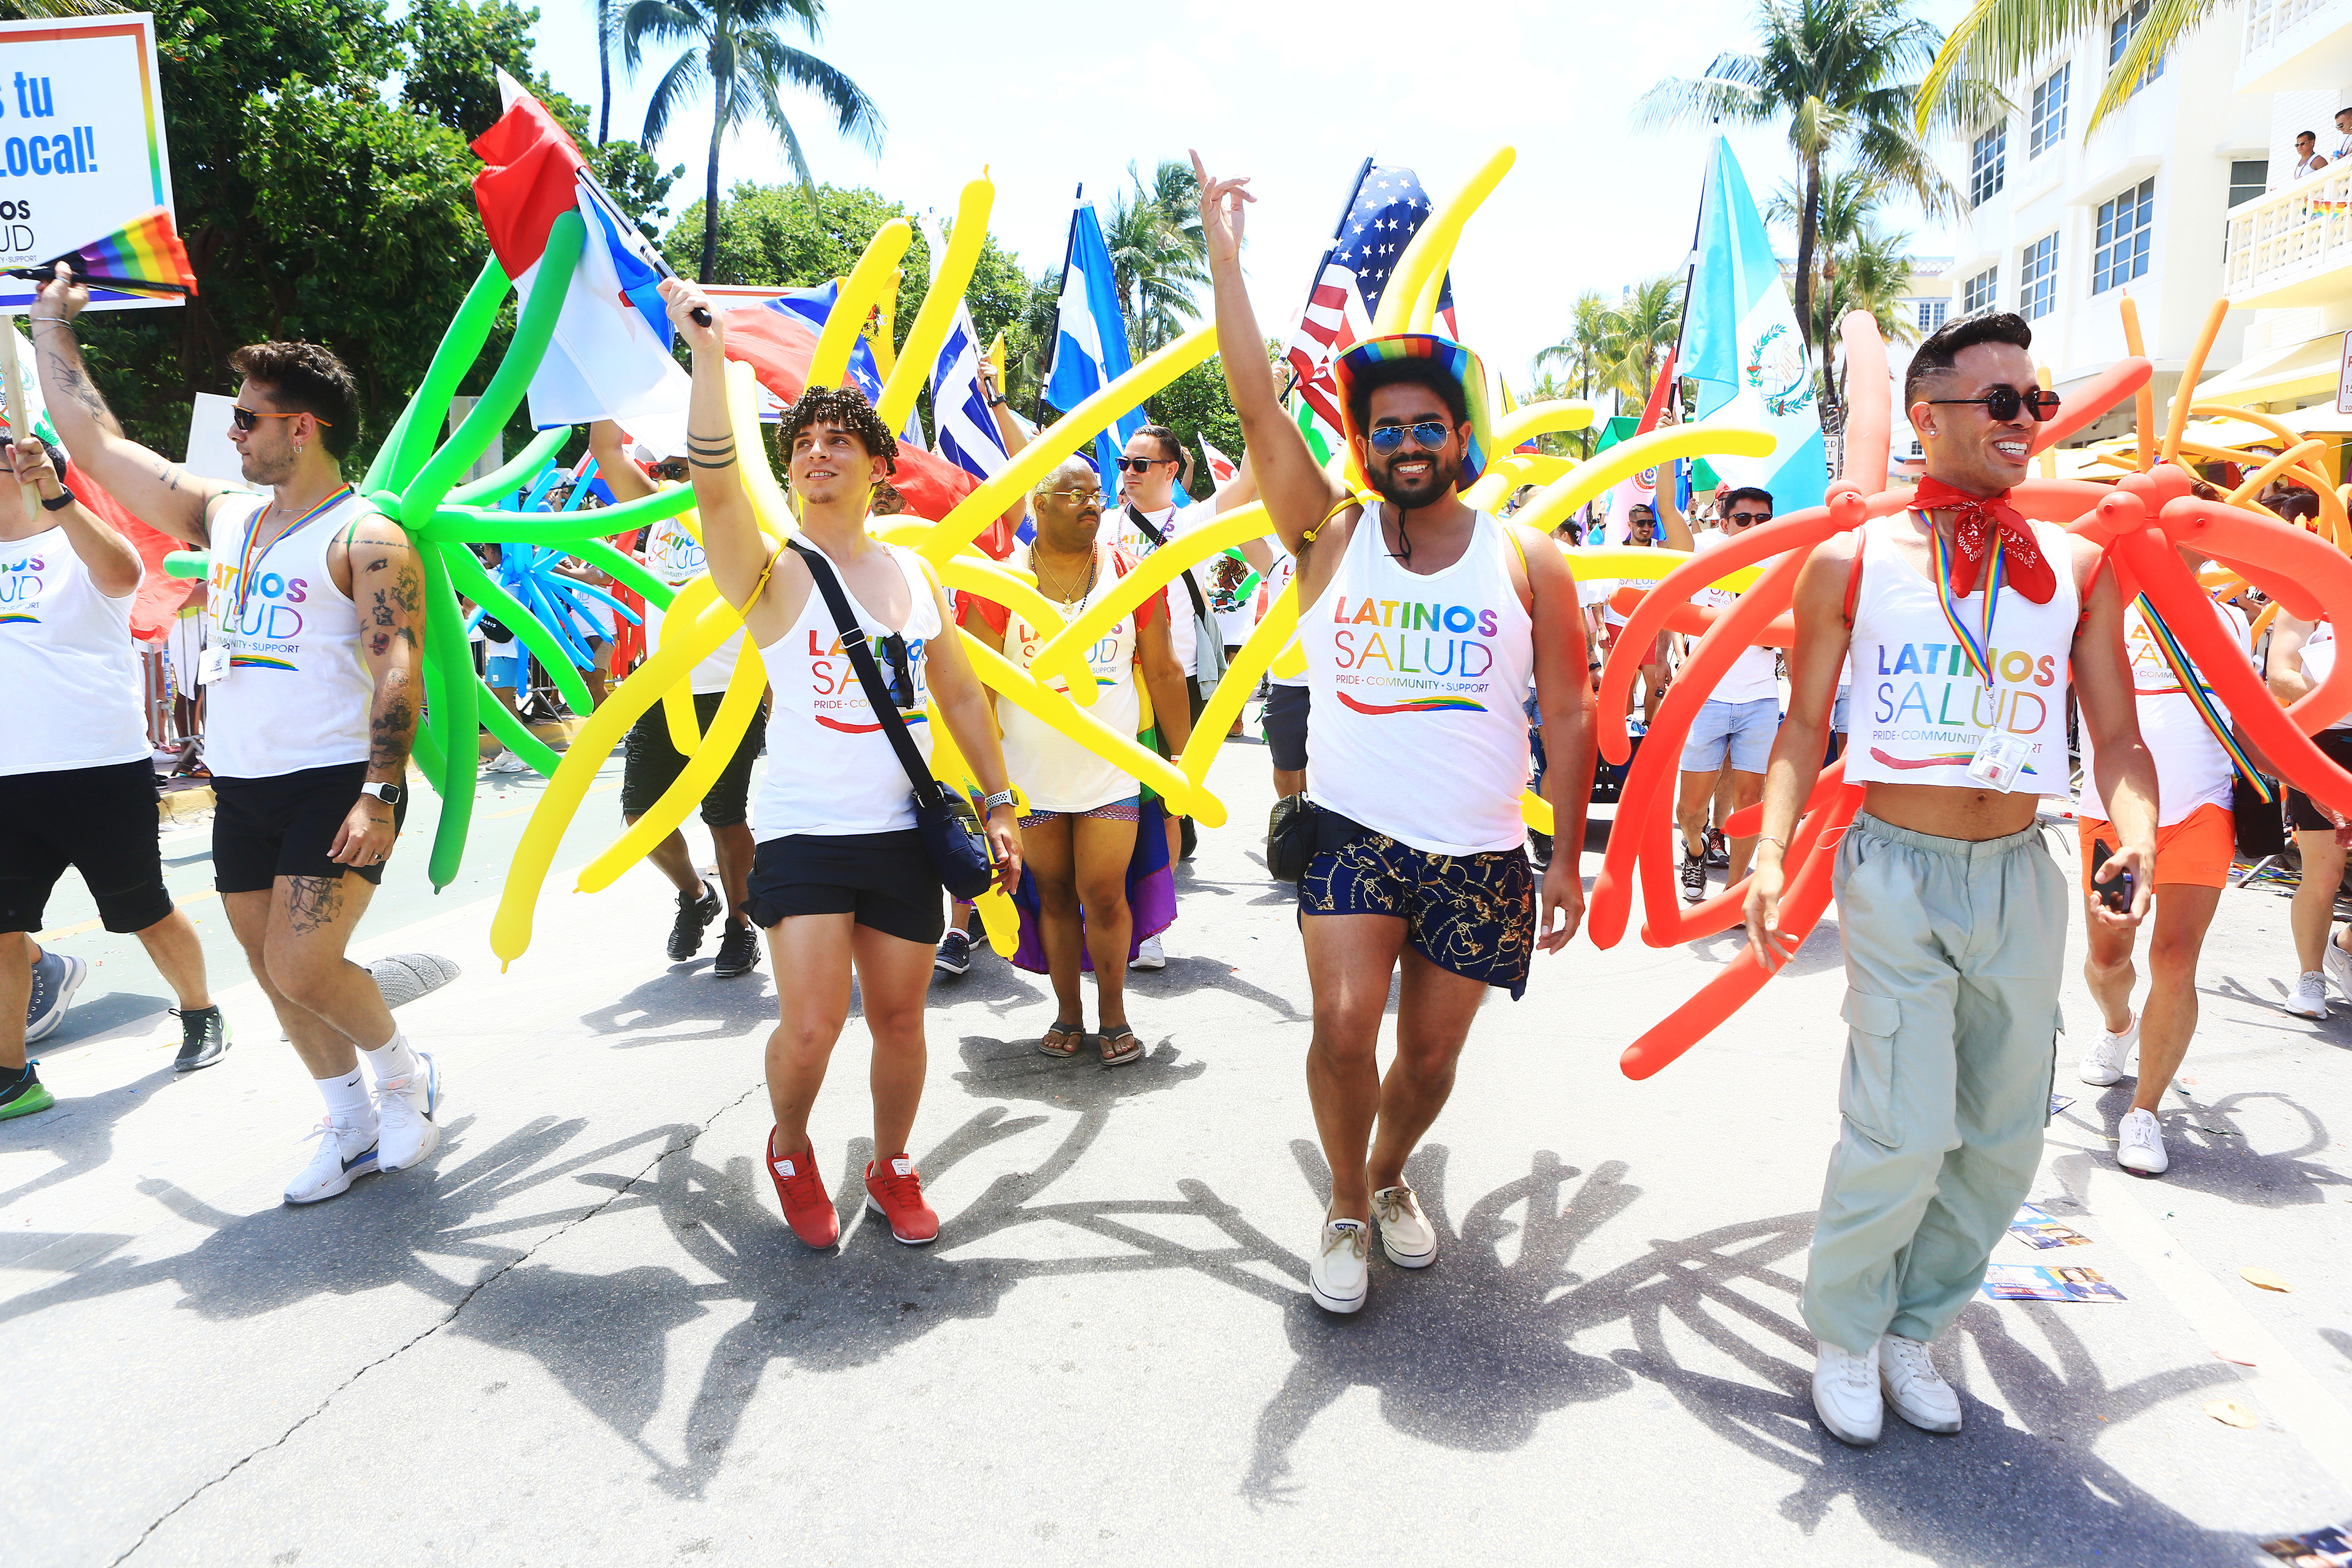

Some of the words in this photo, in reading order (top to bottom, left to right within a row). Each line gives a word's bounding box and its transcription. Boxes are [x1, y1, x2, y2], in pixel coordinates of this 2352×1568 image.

[14, 71, 54, 118] tu
[0, 126, 98, 177] ocal!
[208, 595, 303, 639] ALUD
[1334, 596, 1498, 637] LATINOS
[252, 641, 300, 653] SUPPORT
[1335, 630, 1492, 677] SALUD
[1878, 643, 2054, 687] LATINOS
[814, 700, 843, 708] PRIDE
[1336, 674, 1359, 685] PRIDE
[1367, 676, 1439, 690] COMMUNITY
[1446, 682, 1489, 693] SUPPORT
[1875, 681, 2046, 734] SALUD
[1873, 731, 1896, 740] PRIDE
[1902, 730, 1983, 745] COMMUNITY
